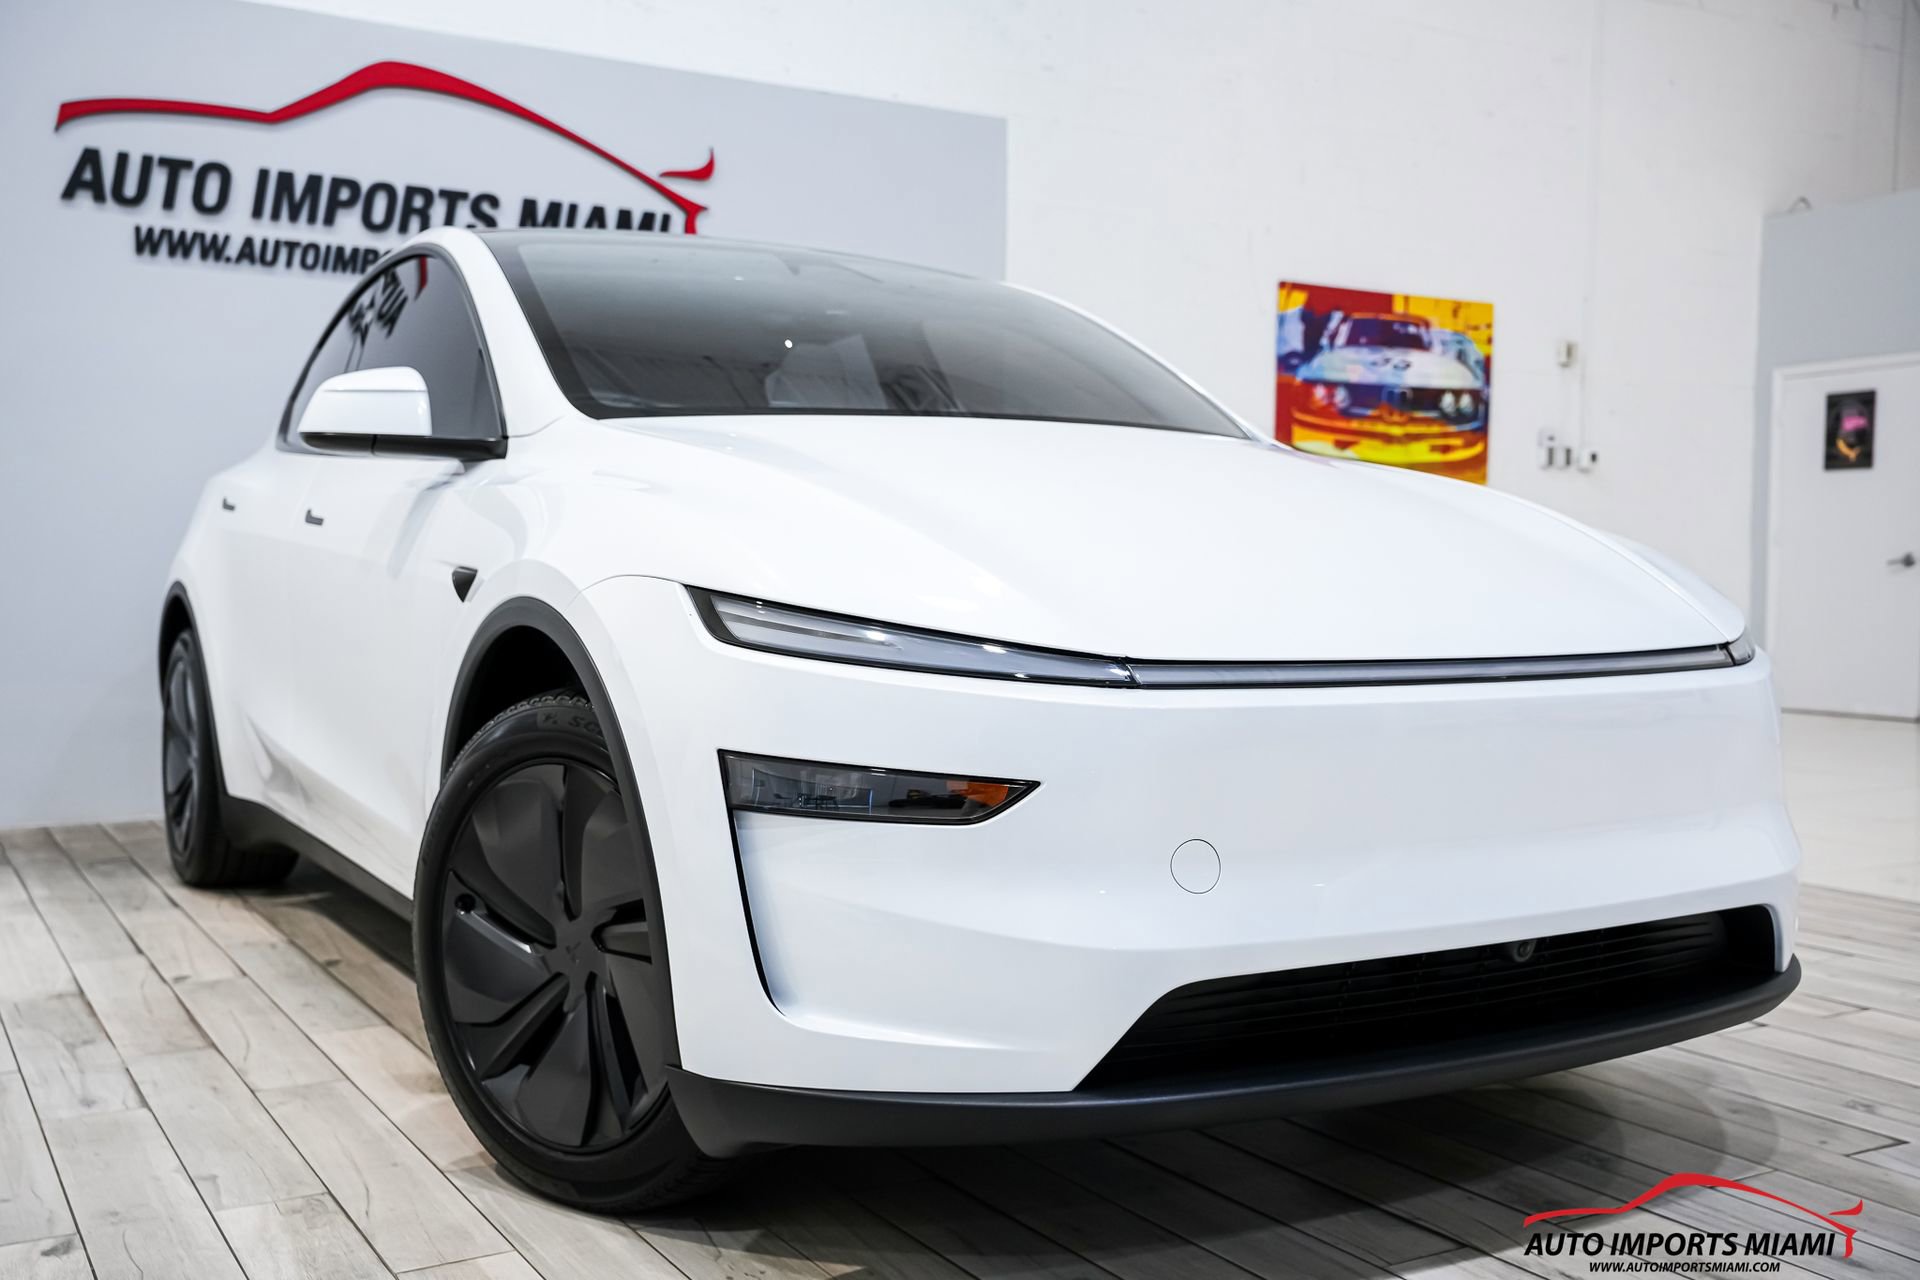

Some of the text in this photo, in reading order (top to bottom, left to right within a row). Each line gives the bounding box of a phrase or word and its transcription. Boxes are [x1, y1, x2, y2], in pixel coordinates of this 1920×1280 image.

[60, 147, 232, 216] AUTO
[251, 167, 500, 235] IMPORTS
[134, 224, 386, 275] WWW.AUTOIMP
